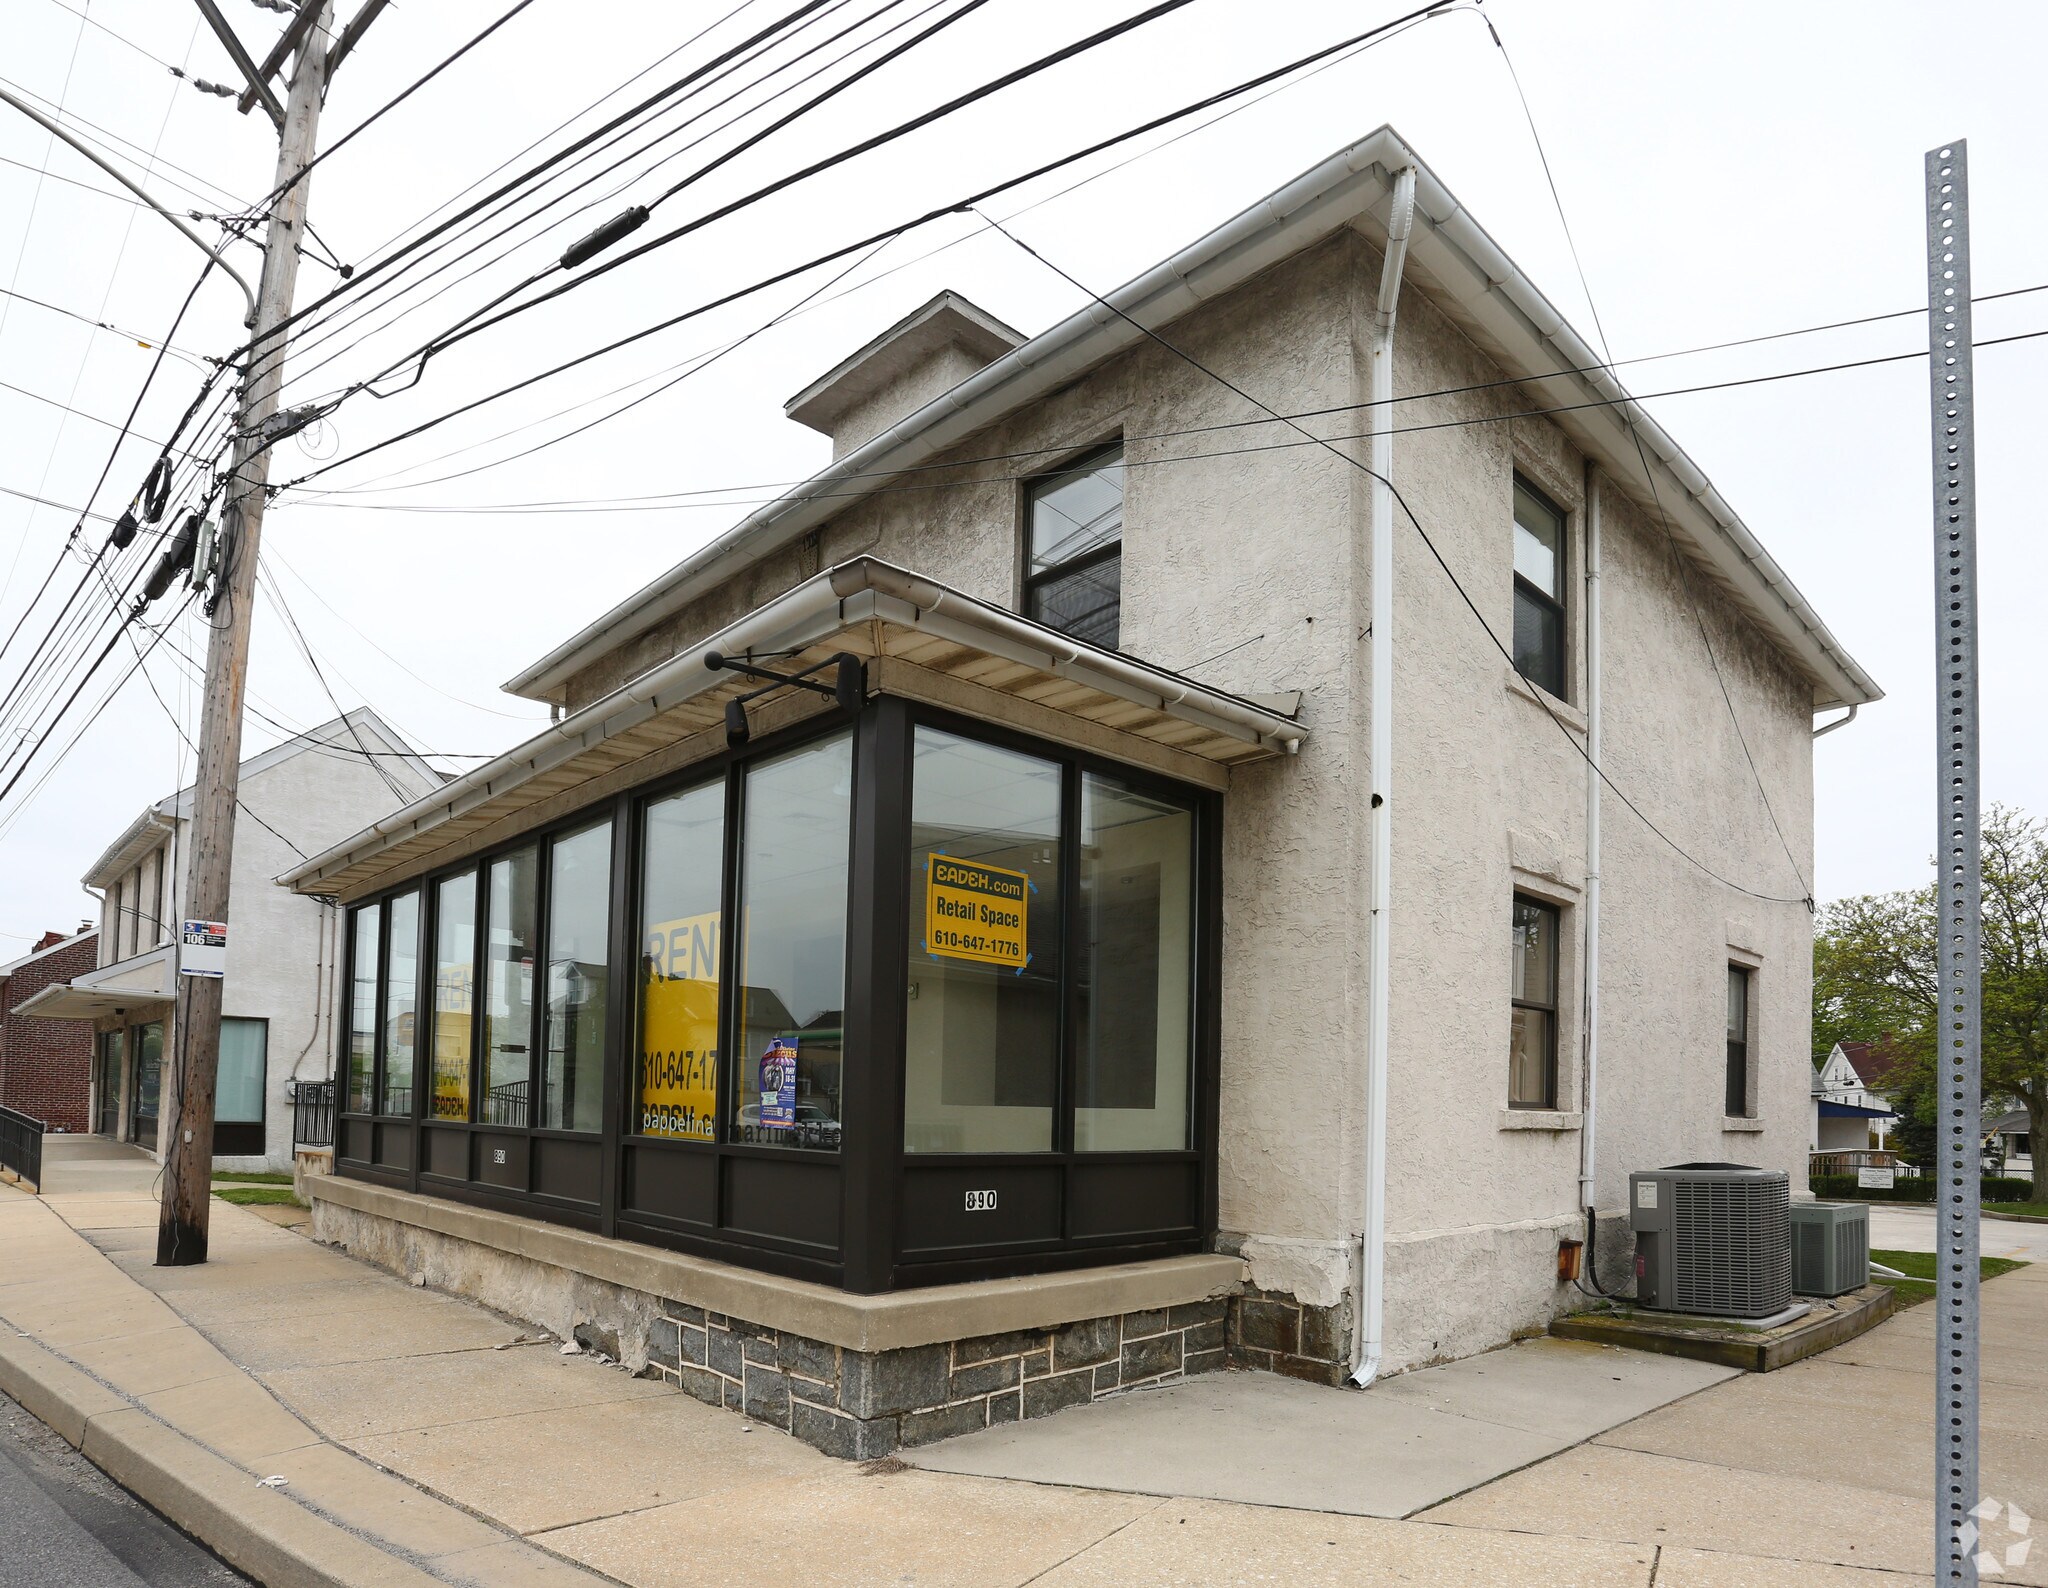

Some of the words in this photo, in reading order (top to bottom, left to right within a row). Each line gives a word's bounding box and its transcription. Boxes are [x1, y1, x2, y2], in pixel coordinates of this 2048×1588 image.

[936, 864, 1020, 896] EADEH.com
[937, 896, 976, 920] Retail
[980, 904, 1019, 928] Space
[185, 934, 205, 945] 106
[647, 921, 720, 984] REN
[935, 930, 1019, 956] 610-647-1776
[967, 1191, 995, 1209] 890
